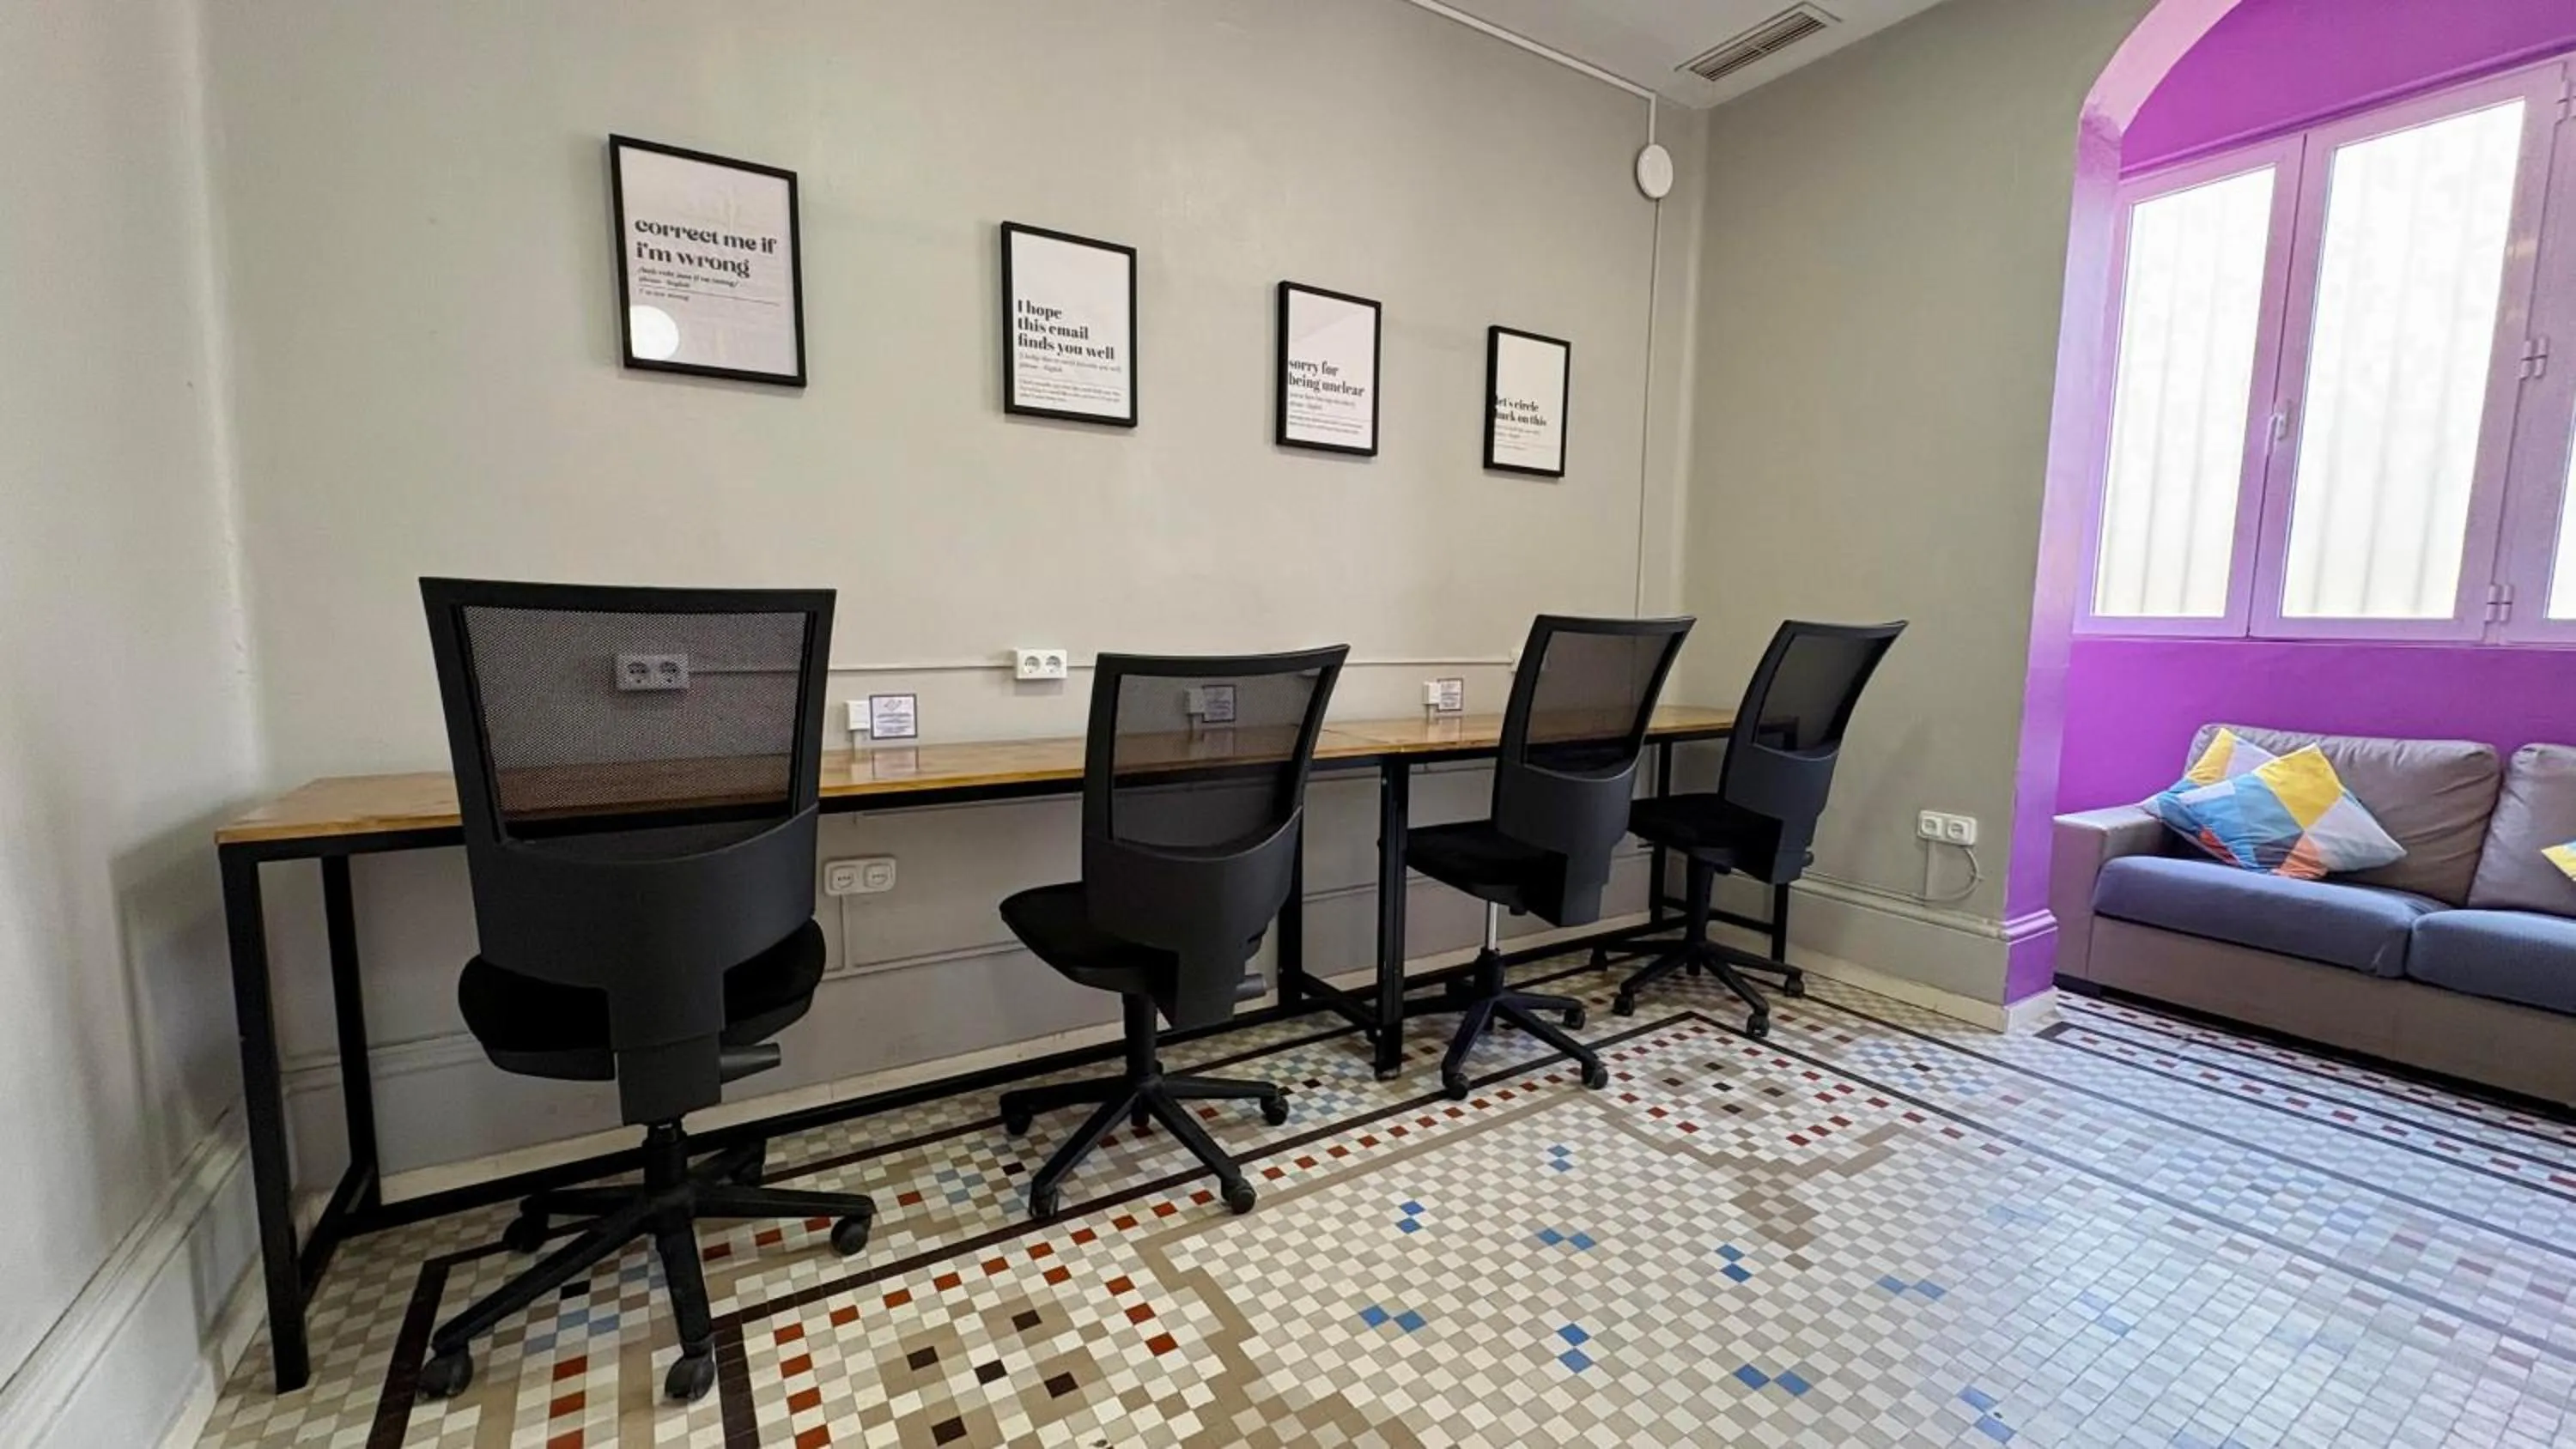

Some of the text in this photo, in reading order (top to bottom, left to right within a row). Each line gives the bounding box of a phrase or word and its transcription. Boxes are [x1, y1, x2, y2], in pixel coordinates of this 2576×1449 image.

[635, 219, 777, 255] correct me if
[635, 242, 671, 264] i'm
[677, 252, 750, 278] wrong
[1018, 300, 1062, 320] I hope
[1018, 317, 1089, 340] this email
[1018, 333, 1115, 360] finds you well
[1289, 361, 1339, 376] sorry for
[1289, 372, 1365, 397] being unclear
[1515, 399, 1539, 411] circle
[1530, 415, 1546, 426] this
